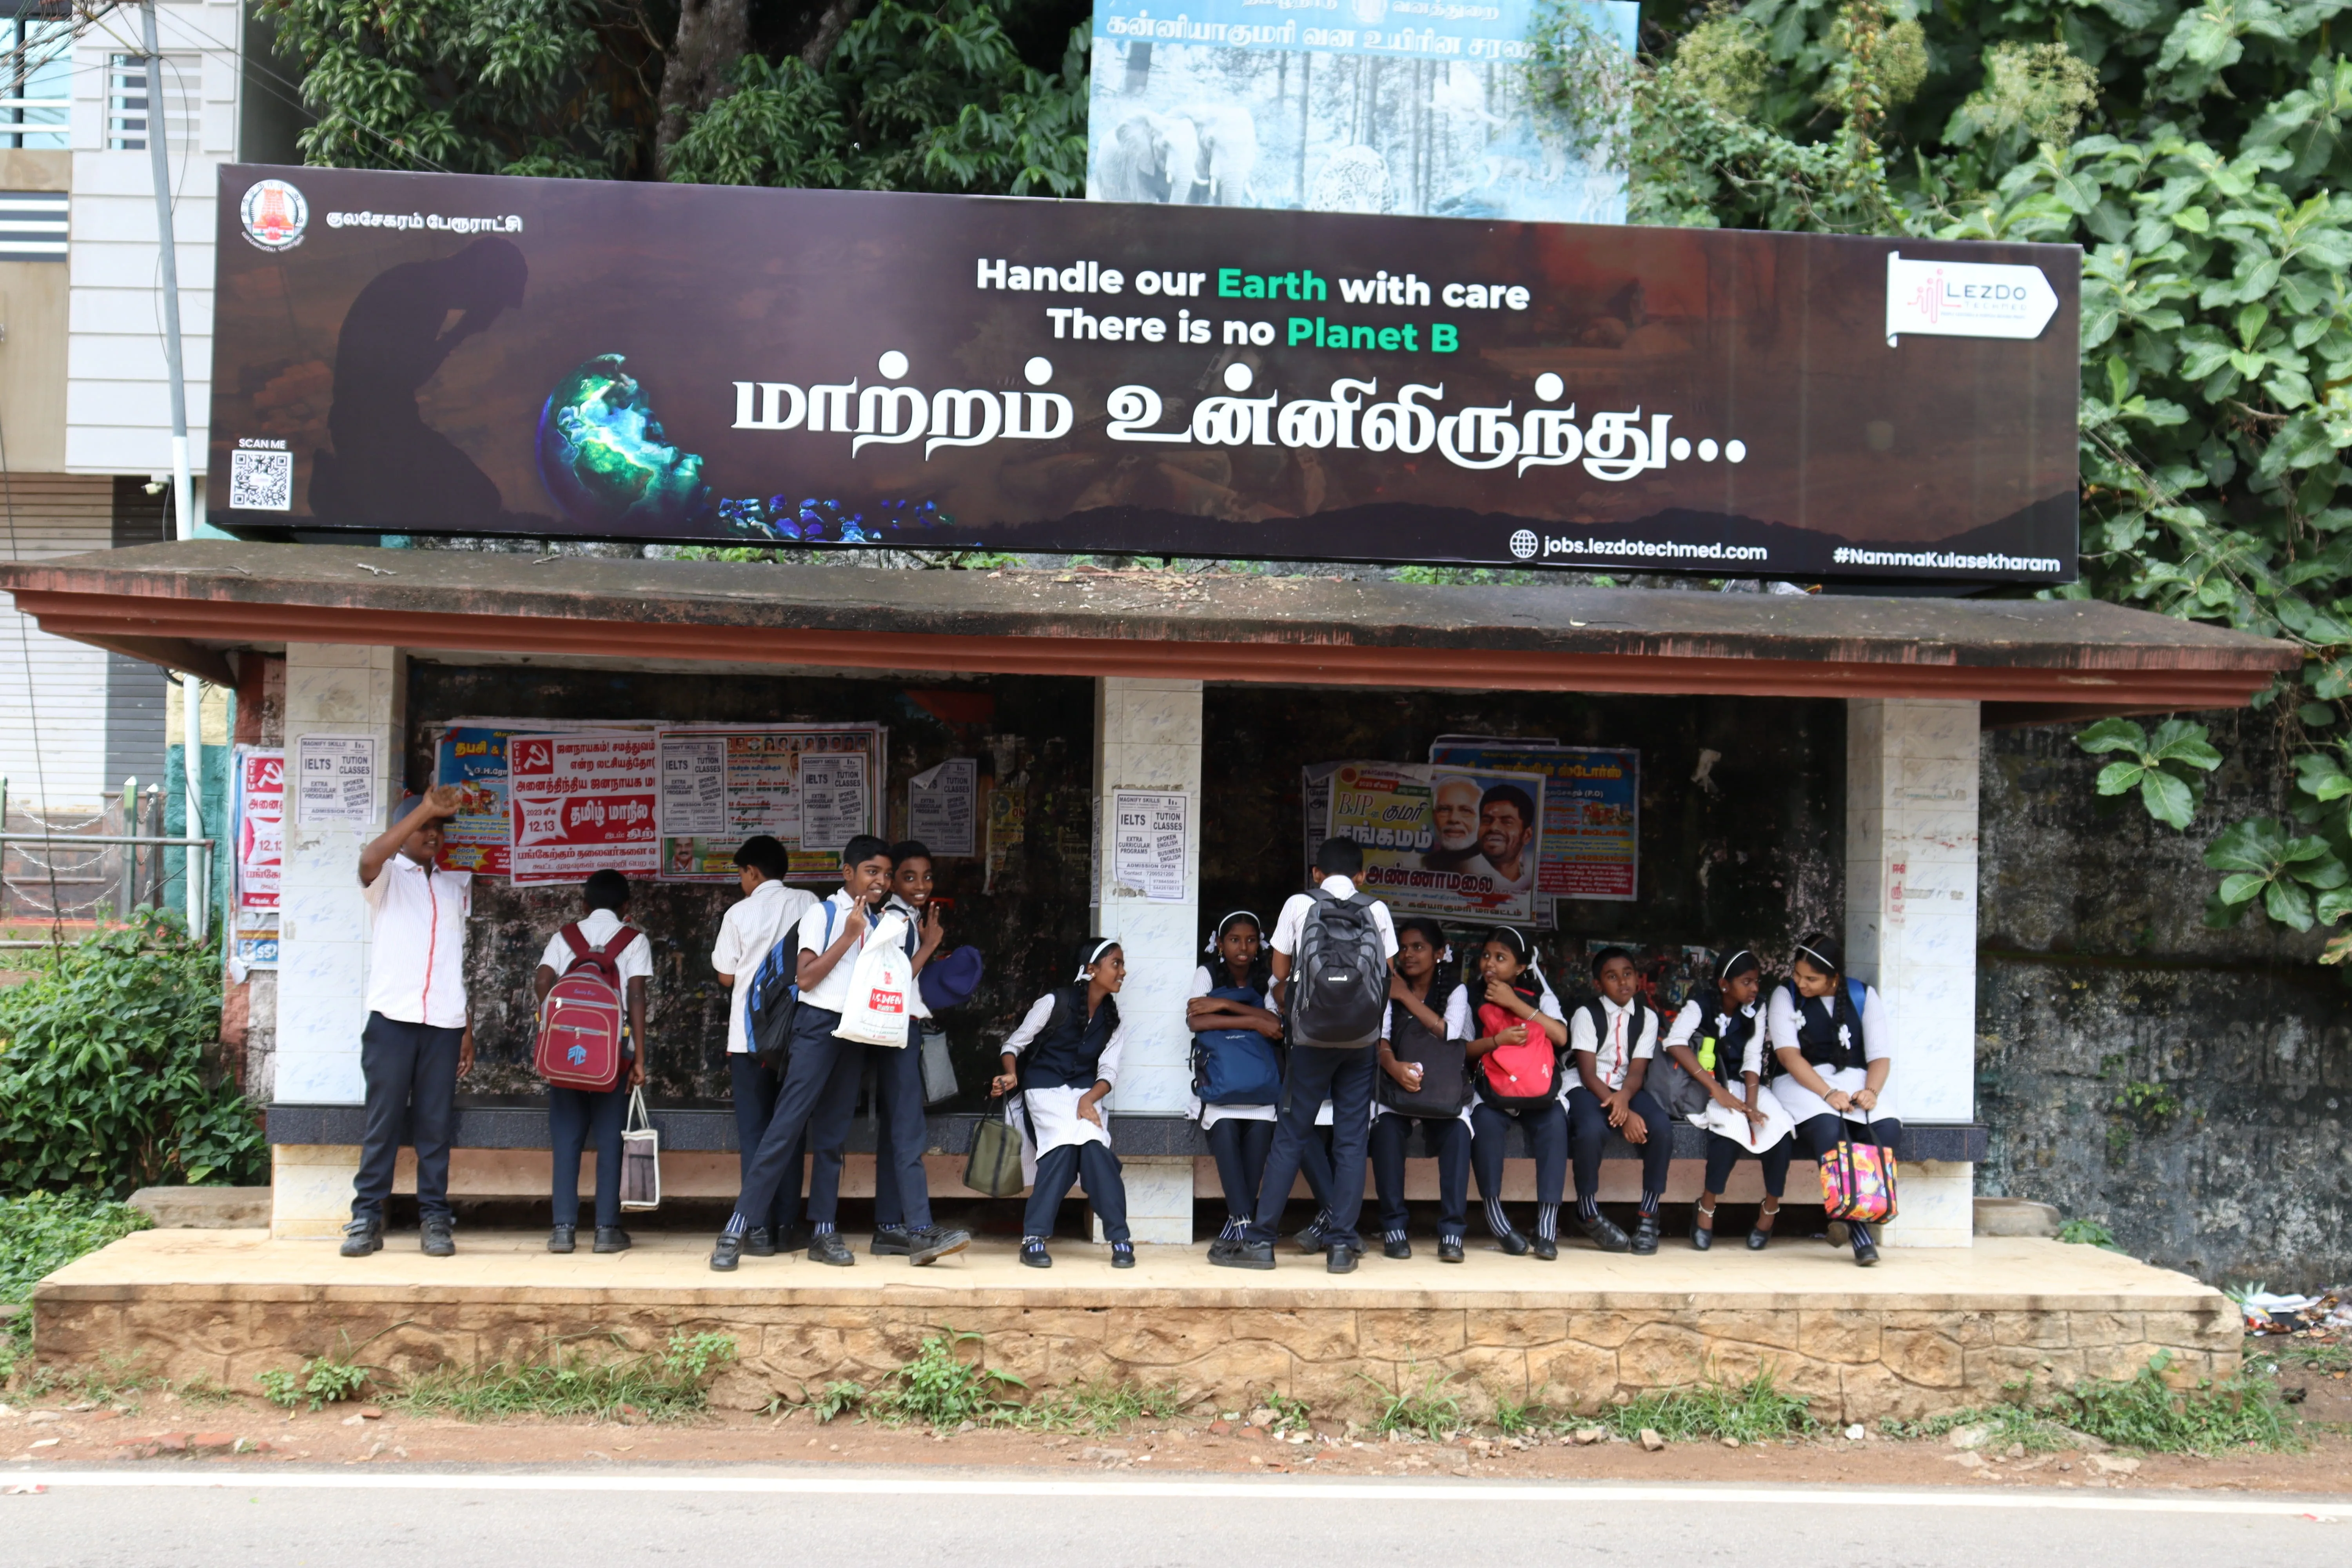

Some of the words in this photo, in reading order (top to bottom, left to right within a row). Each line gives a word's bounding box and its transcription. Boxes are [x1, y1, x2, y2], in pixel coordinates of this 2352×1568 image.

[1106, 9, 1296, 46] கன்னியாகுமரி
[1302, 27, 1357, 48] வன
[1363, 28, 1463, 55] உயிரின
[326, 210, 424, 230] குலசேகரம்
[426, 214, 523, 234] பேரூராட்சி
[976, 258, 1123, 293] Handle
[1135, 267, 1206, 297] our
[1218, 268, 1327, 301] Earth
[1338, 270, 1431, 307] with
[1442, 279, 1530, 310] care
[1047, 307, 1167, 342] There
[1178, 309, 1212, 344] is
[1223, 318, 1276, 345] no
[1287, 317, 1418, 351] Planet
[1431, 324, 1459, 353] B
[731, 350, 1073, 461] மாற்றம்
[239, 438, 268, 448] SCAN
[270, 440, 286, 449] ME
[1543, 535, 1768, 561] jobs.lezdotechmed.com
[1833, 546, 2061, 572] #NammaKulasekharam
[490, 745, 500, 756] &
[305, 758, 331, 770] IELTS
[342, 756, 368, 764] TUTION
[570, 758, 594, 771] என்ற
[666, 760, 688, 770] IELTS
[339, 766, 370, 774] CLASSES
[342, 778, 364, 787] SPOKEN
[698, 776, 716, 784] SPOKEN
[806, 774, 828, 784] IELTS
[343, 784, 366, 793] ENGLISH
[515, 776, 588, 794] அனைத்திந்திய
[590, 777, 642, 793] ஜனநாயக
[699, 781, 718, 789] ENGLISH
[344, 791, 370, 802] BUSINESS
[700, 787, 721, 797] BUSINESS
[702, 792, 721, 801] ENGLISH
[838, 789, 856, 798] SPOKEN
[1584, 789, 1604, 798] (P.O)
[347, 798, 370, 808] ENGLISH
[839, 795, 858, 803] ENGLISH
[840, 802, 861, 811] BUSINESS
[842, 807, 861, 815] ENGLISH
[1382, 801, 1429, 822] குமரி
[570, 799, 605, 828] தமிழ்
[608, 800, 648, 826] மாநில
[1156, 812, 1181, 821] TUTION
[1121, 813, 1146, 826] IELTS
[528, 821, 555, 832] 12.13
[1153, 822, 1182, 831] CLASSES
[1156, 834, 1176, 843] SPOKEN
[1157, 840, 1178, 849] ENGLISH
[517, 846, 575, 861] பங்கேற்கும்
[1157, 847, 1182, 857] BUSINESS
[1160, 854, 1181, 863] ENGLISH
[1365, 862, 1495, 893] அண்ணாமலை
[1475, 906, 1523, 917] மாவட்டம்
